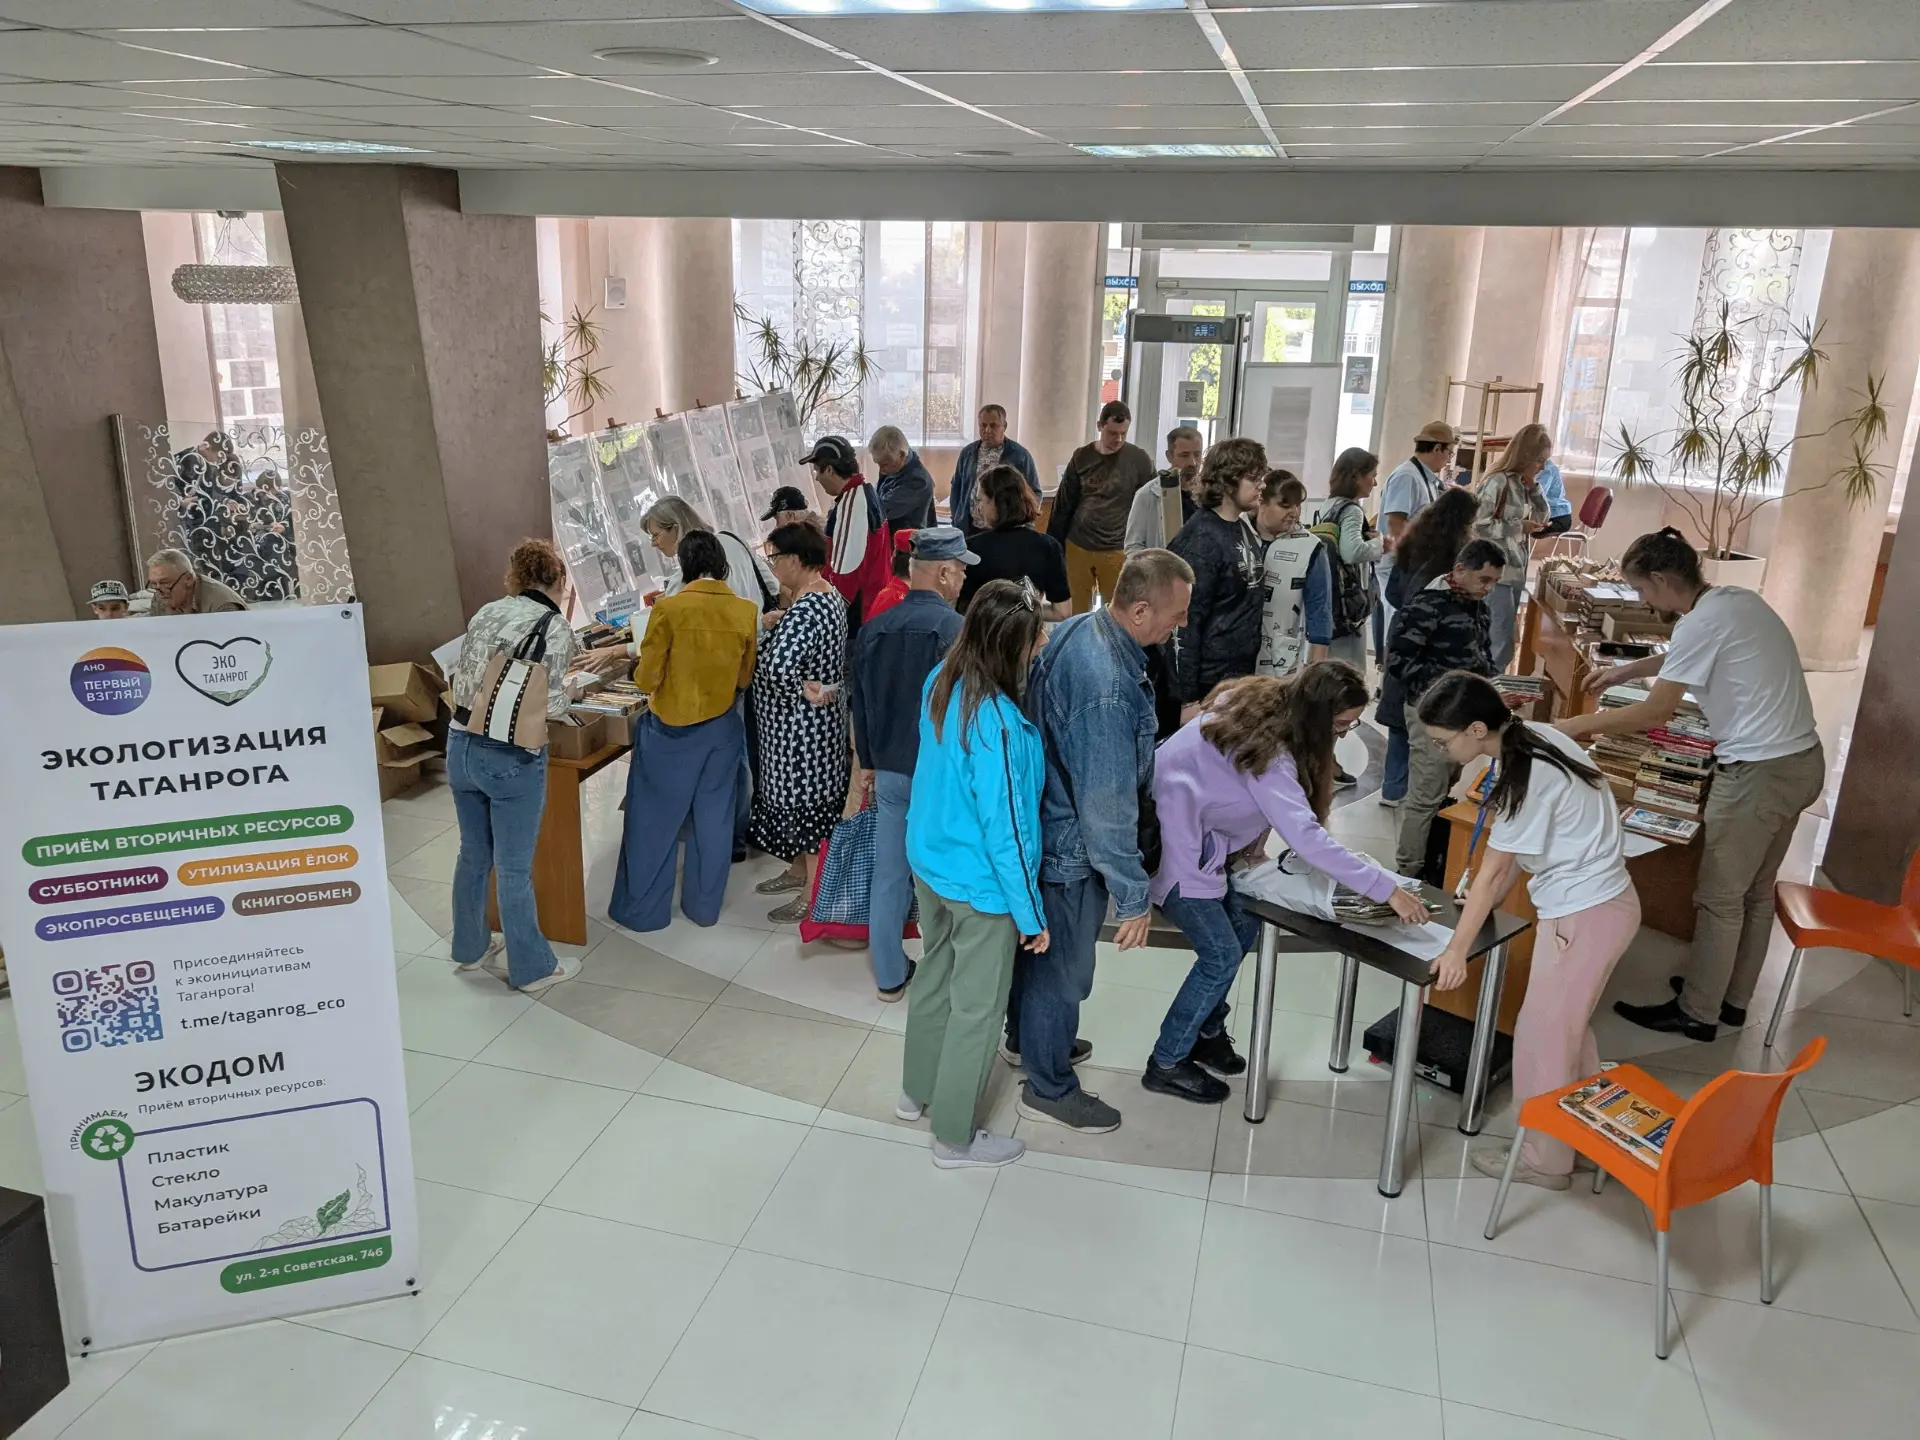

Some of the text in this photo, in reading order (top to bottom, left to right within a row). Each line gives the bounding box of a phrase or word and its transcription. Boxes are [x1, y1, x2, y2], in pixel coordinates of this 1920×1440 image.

[1350, 282, 1384, 292] ВЫХОД
[83, 663, 105, 672] АНО
[212, 655, 237, 670] ЭКО
[84, 677, 141, 691] ПЕРВЫЙ
[203, 671, 248, 684] ТАГАНРОГ
[86, 688, 144, 702] ВЗГЛЯД
[40, 725, 327, 770] ЭКОЛОГИЗАЦИЯ
[90, 764, 290, 801] ТАГАНРОГА
[36, 814, 341, 858] ПРИЁМ ВТОРИЧНЫХ РЕСУРСОВ
[188, 852, 349, 880] УТИЛИЗАЦИЯ ЁЛОК
[39, 873, 160, 897] СУББОТНИКИ
[241, 887, 353, 909] КНИГООБМЕН
[45, 903, 216, 934] ЭКОПРОСВЕЩЕНИЕ
[173, 945, 305, 972] Присоединяйтесь
[175, 961, 311, 986] к экоинициативам
[177, 982, 255, 1002] Таганрога!
[180, 998, 346, 1030] t.me/taganrog_eco
[134, 1051, 286, 1093] ЭКОДОМ
[138, 1078, 327, 1116] Приём вторичных ресурсов:
[70, 1109, 129, 1150] ПРИНИМАЕМ
[147, 1143, 230, 1165] Пластик
[151, 1168, 221, 1188] Стекло
[154, 1184, 268, 1212] Макулатура
[157, 1208, 261, 1235] Батарейки
[235, 1272, 256, 1285] ул.
[259, 1267, 280, 1279] 2-я
